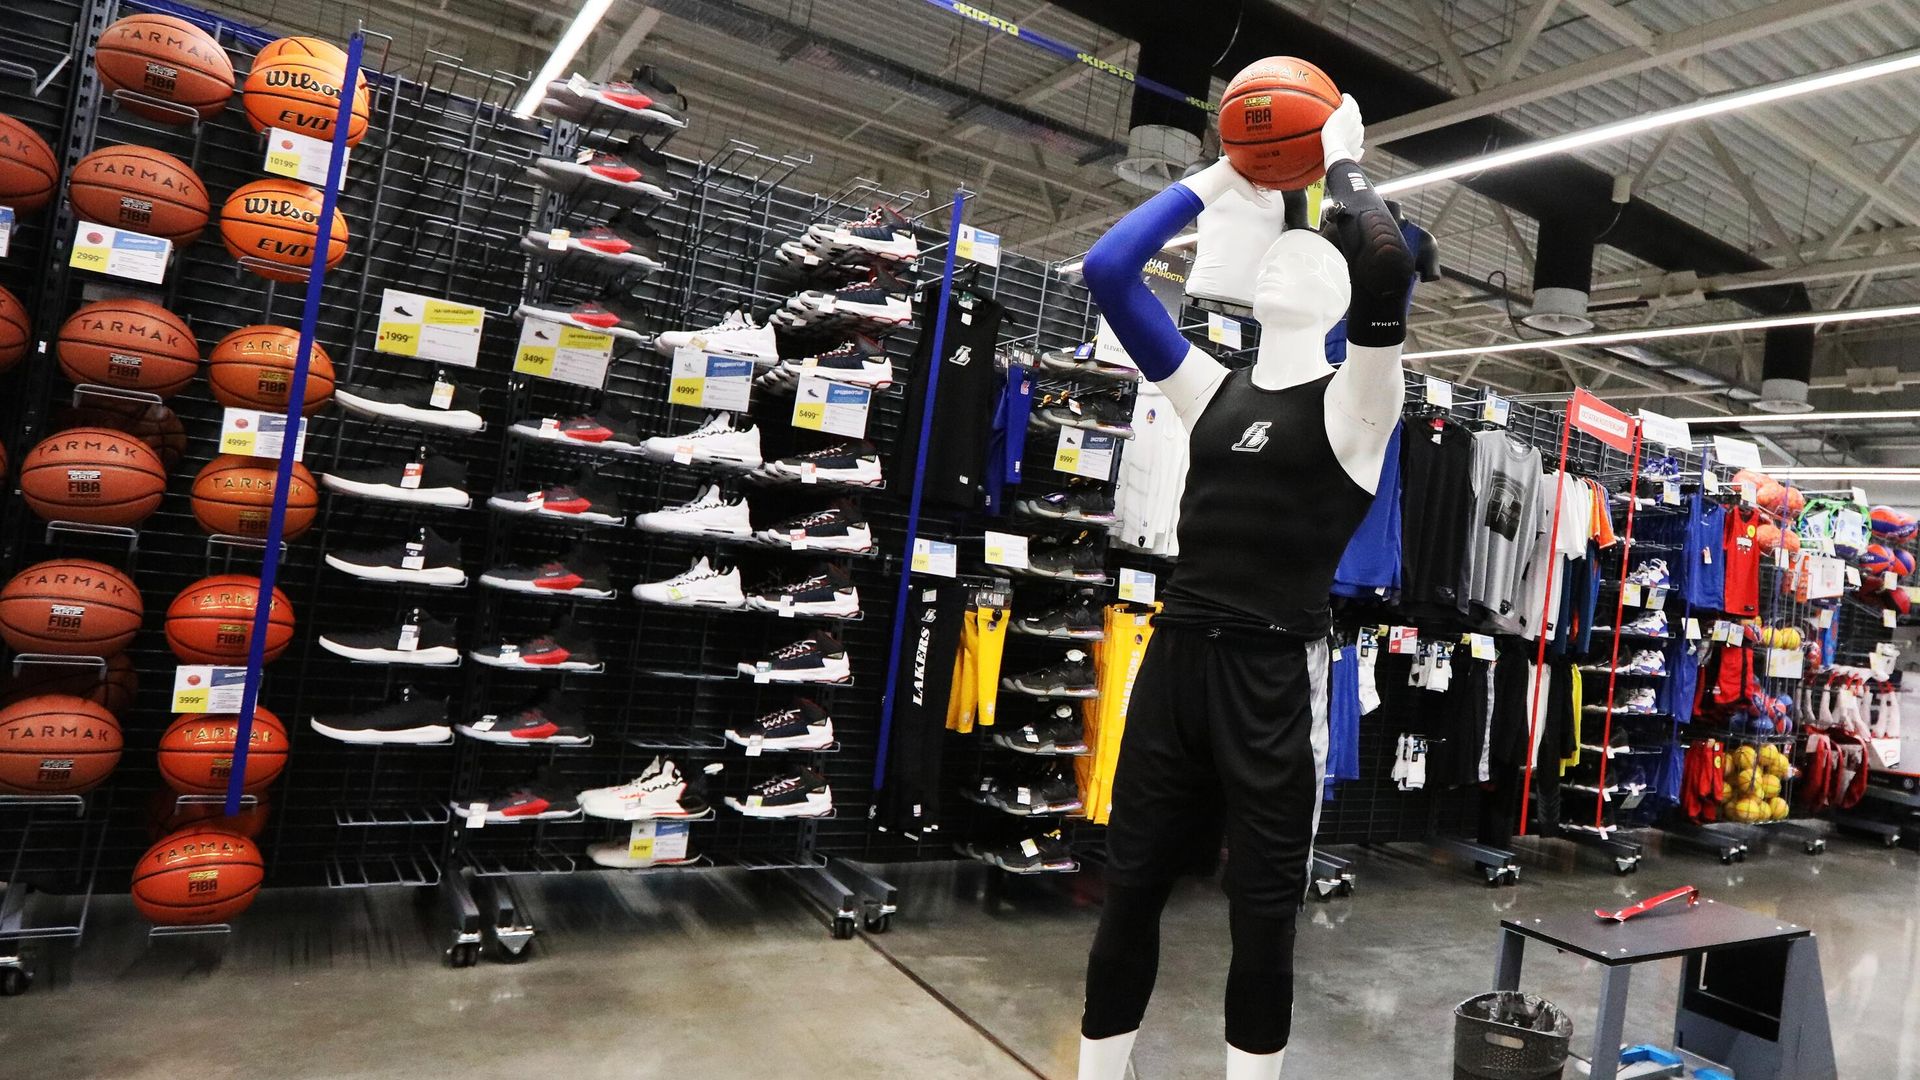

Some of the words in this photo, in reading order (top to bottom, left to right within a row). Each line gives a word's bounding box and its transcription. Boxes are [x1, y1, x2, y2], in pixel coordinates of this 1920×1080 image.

[120, 28, 215, 65] TARMAK
[1245, 108, 1271, 125] FIBA
[94, 162, 190, 195] TARMAK
[120, 209, 151, 223] FIBA
[77, 252, 99, 262] 2999
[1144, 258, 1169, 272] НАЯ
[82, 319, 179, 347] TARMAK
[385, 331, 409, 343] 1999
[233, 340, 320, 363] TARMK
[523, 353, 544, 365] 3499
[108, 364, 140, 378] FIBA
[258, 379, 287, 392] FIBA
[676, 386, 696, 395] 4999
[799, 409, 816, 419] 5499
[226, 437, 247, 447] 4999
[38, 441, 138, 459] TARMAK
[68, 481, 101, 493] FIBA
[212, 477, 303, 496] TARMK
[238, 518, 267, 531] FIBA
[24, 573, 124, 598] TARMAK
[192, 593, 278, 612] TARMK
[48, 616, 82, 628] FIBA
[217, 633, 246, 645] FIBA
[912, 626, 931, 707] LAKERS
[8, 725, 109, 741] TARMAK
[210, 767, 231, 778] FIB
[188, 880, 218, 892] FIBA
